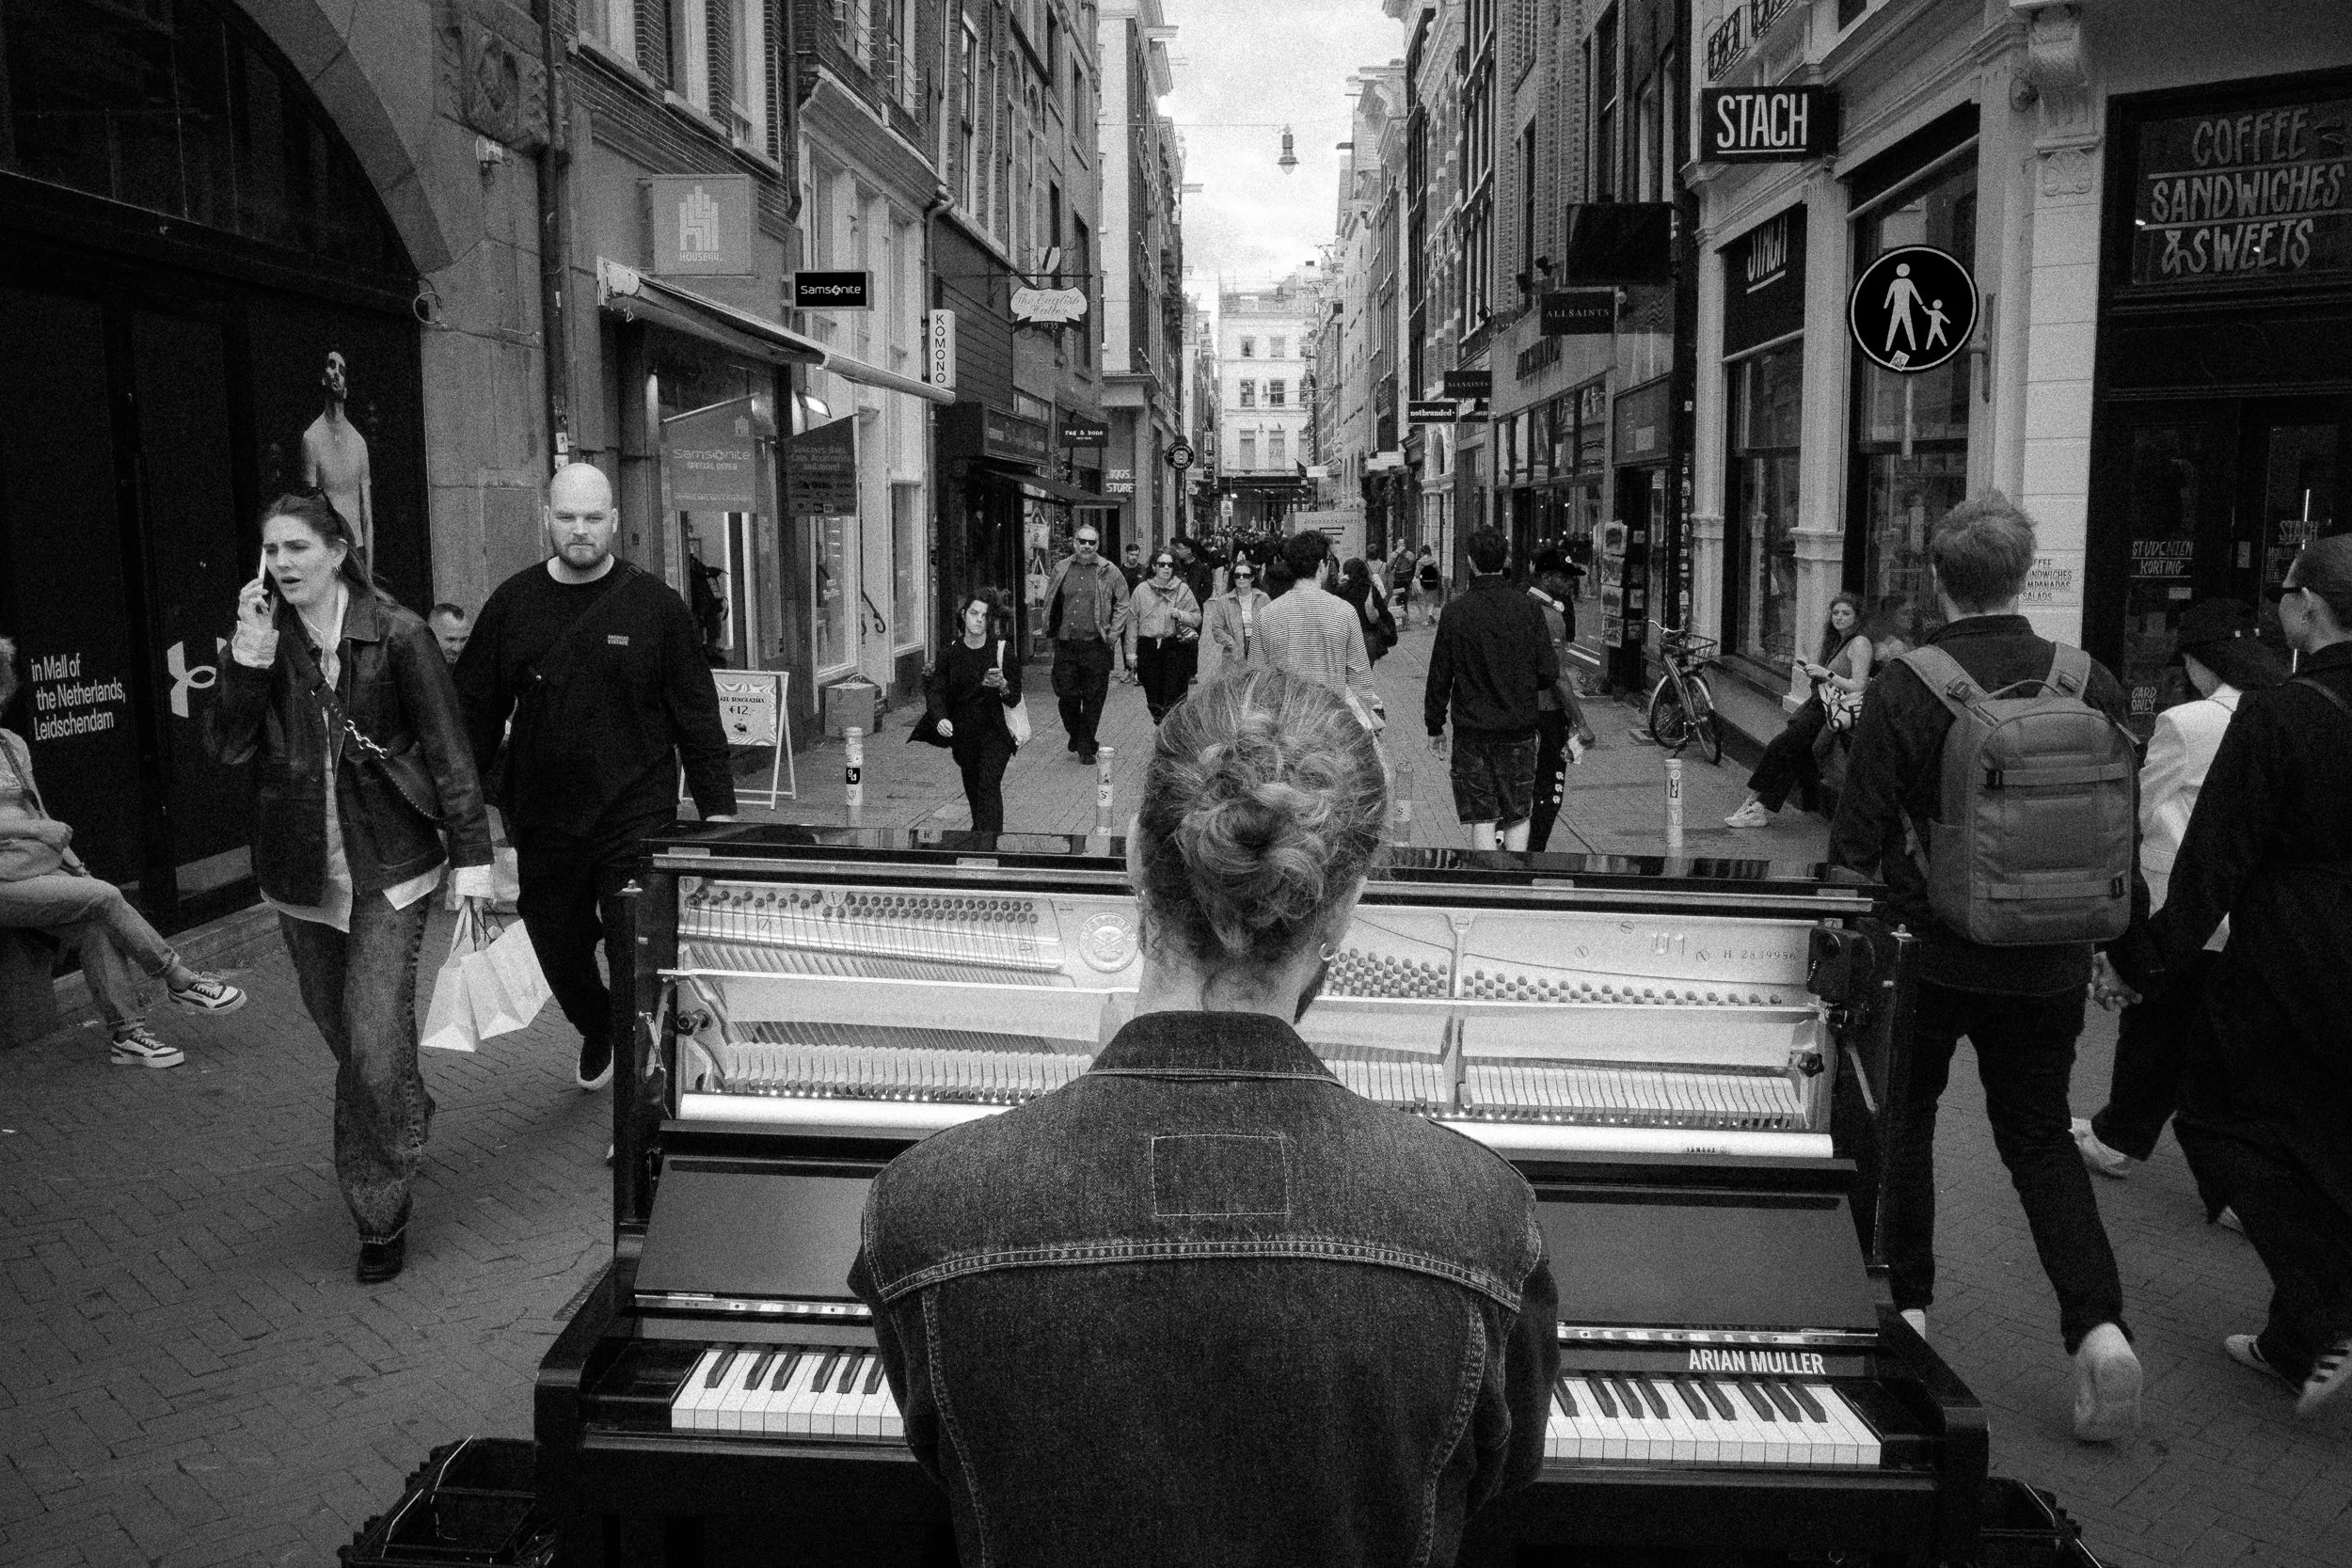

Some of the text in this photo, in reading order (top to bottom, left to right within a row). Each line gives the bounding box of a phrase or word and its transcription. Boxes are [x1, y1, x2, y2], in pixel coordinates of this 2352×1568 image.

[1717, 93, 1807, 148] STACH
[2192, 108, 2309, 166] COFFEE
[2151, 164, 2345, 222] SANDWICHES
[801, 284, 861, 295] Samsonite
[1016, 293, 1034, 305] The
[1546, 309, 1610, 318] ALLSAINTS
[935, 314, 946, 384] KOMONO
[673, 449, 751, 461] Samsonite
[1106, 483, 1134, 493] STORE
[2033, 558, 2053, 568] FFEE
[2139, 560, 2185, 575] KORTING
[2026, 580, 2071, 591] MPANADAS
[2023, 592, 2052, 602] SALADS
[31, 653, 80, 682] in Mall of
[36, 677, 126, 711] the Netherlands,
[2131, 686, 2157, 699] CARD
[2131, 698, 2156, 712] ONLY
[34, 708, 114, 741] Leidschendam
[1689, 1349, 1826, 1374] ARIAN MULLER
